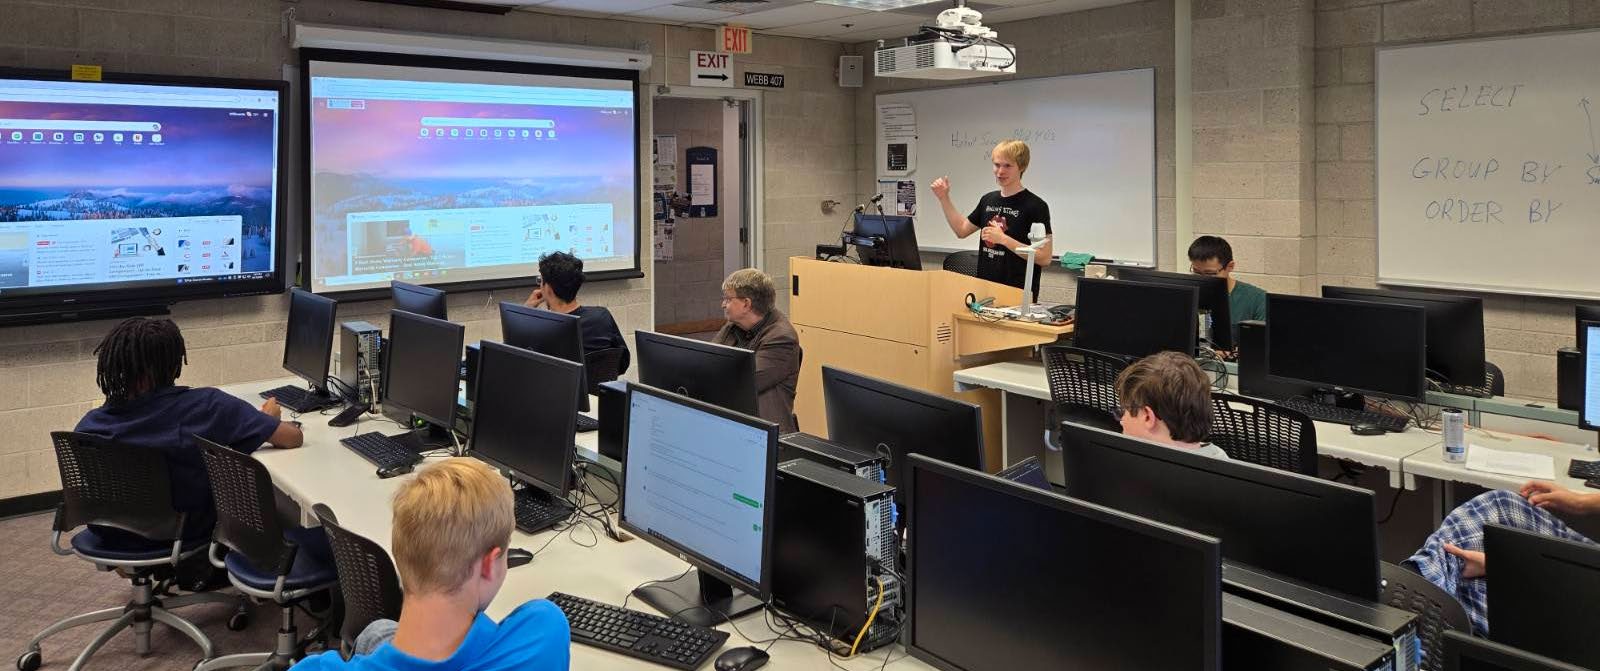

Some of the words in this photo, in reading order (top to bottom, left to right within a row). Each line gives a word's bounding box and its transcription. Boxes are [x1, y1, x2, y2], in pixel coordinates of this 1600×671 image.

[725, 28, 748, 52] EXIT
[697, 53, 729, 68] EXIT
[746, 74, 769, 85] WEBB
[770, 76, 783, 86] 407
[1418, 85, 1524, 116] SELECT
[1411, 157, 1500, 181] GROUP
[1520, 161, 1565, 184] BY
[1425, 199, 1505, 224] ORDER
[1528, 199, 1563, 224] BY
